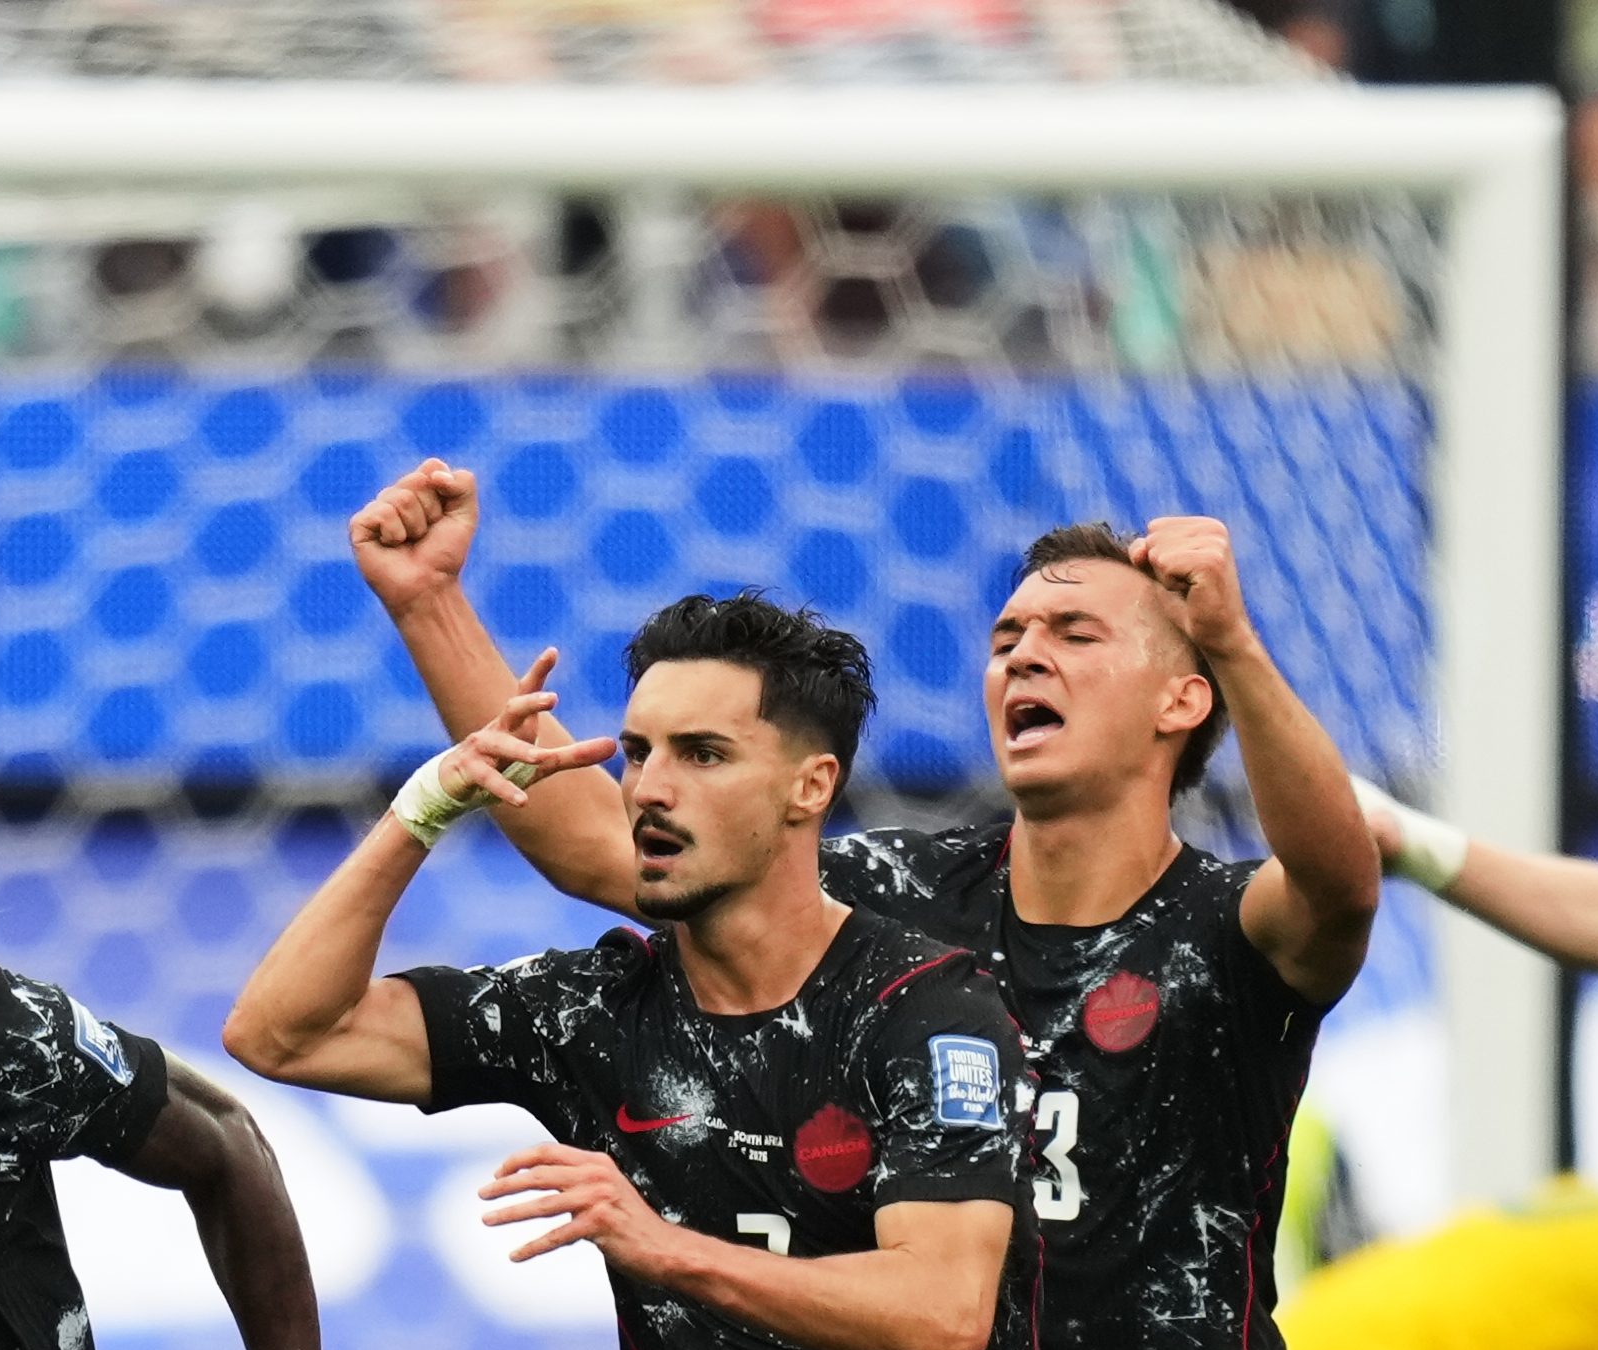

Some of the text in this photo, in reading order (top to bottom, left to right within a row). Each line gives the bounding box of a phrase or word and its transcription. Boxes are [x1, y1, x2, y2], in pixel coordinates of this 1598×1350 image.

[949, 1063, 993, 1088] UNITES
[705, 1116, 728, 1129] CAN
[733, 1130, 762, 1145] SOUTH
[1033, 1091, 1081, 1221] 3
